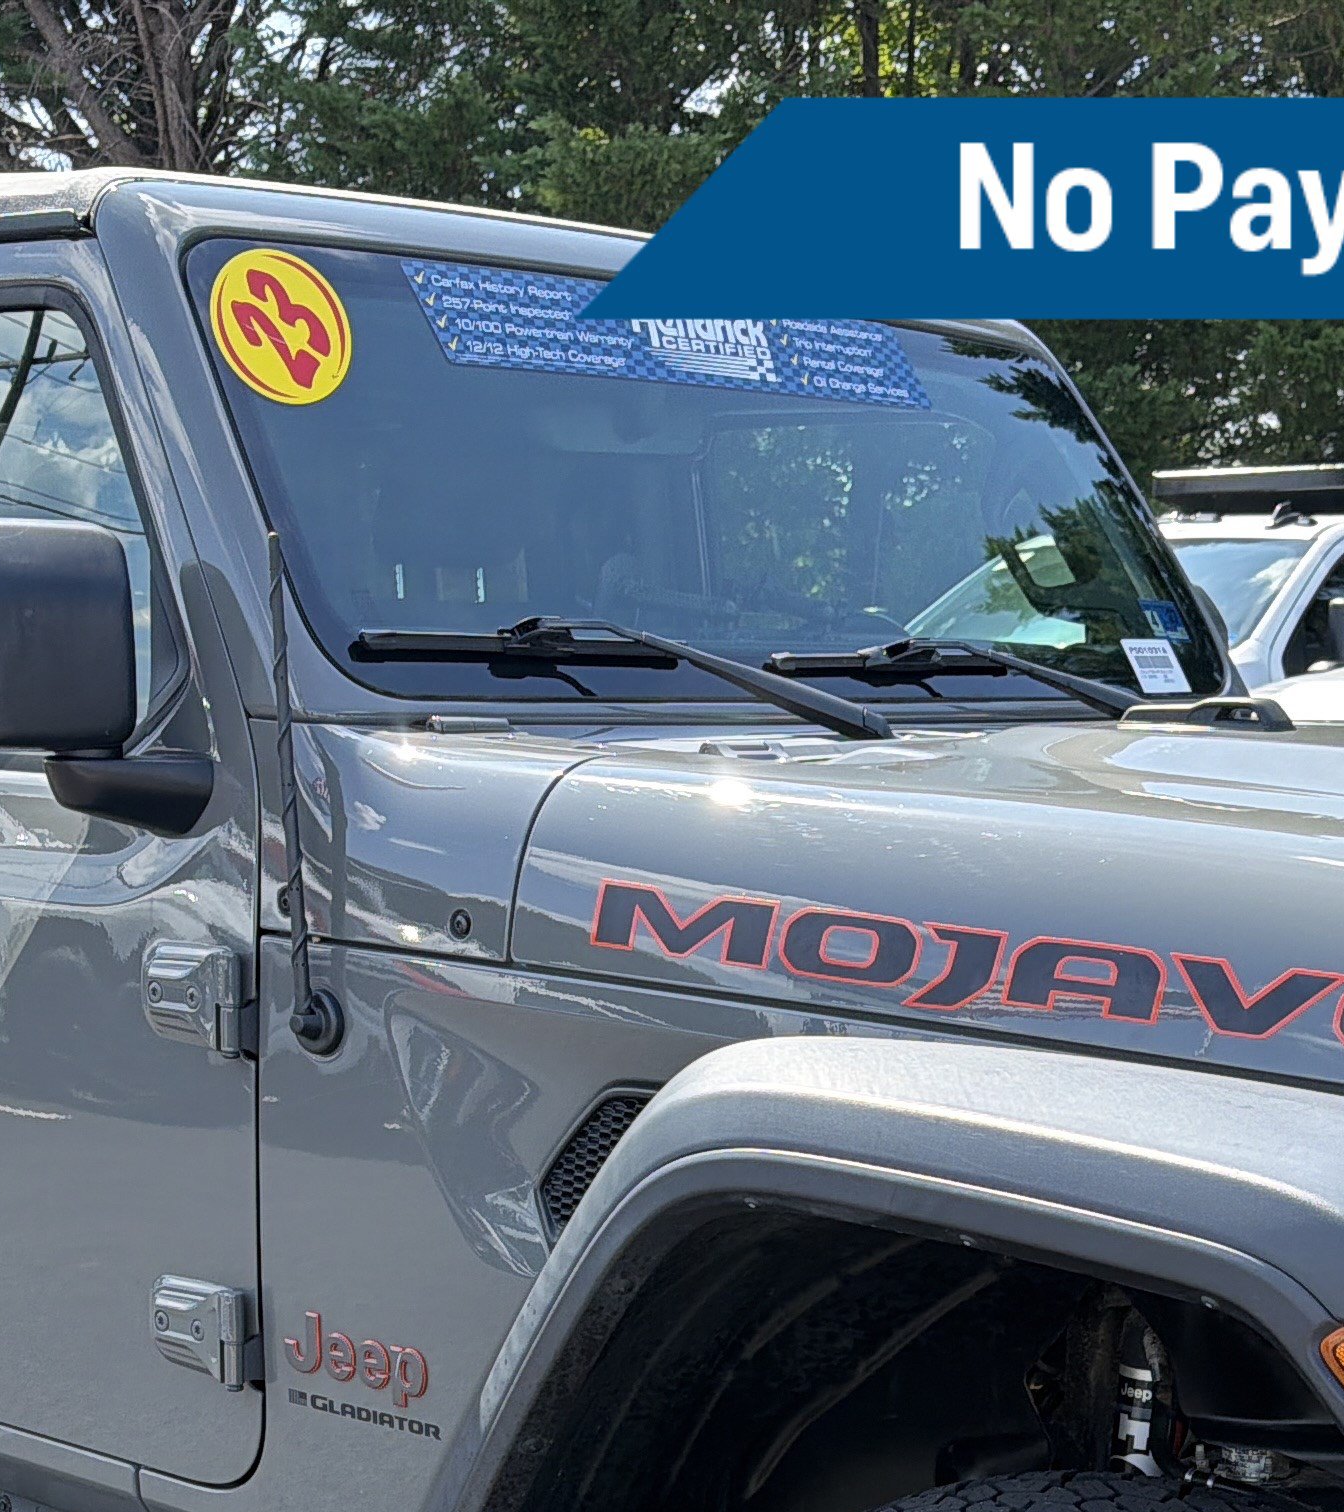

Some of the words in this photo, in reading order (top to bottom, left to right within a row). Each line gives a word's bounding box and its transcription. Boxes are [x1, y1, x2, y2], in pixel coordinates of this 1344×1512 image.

[431, 274, 475, 291] Carfax
[479, 280, 524, 297] History
[528, 285, 573, 301] Report
[231, 268, 331, 389] 23
[454, 318, 502, 334] 10/100
[505, 322, 574, 342] Powertrain
[577, 330, 635, 350] Warranty
[466, 340, 503, 355] 12/12
[507, 344, 566, 361] High-Tech
[568, 350, 627, 368] Coverage
[662, 336, 772, 360] CERTIFIED
[837, 361, 884, 378] Coverage
[867, 383, 910, 399] Services
[284, 1311, 429, 1408] Jeep
[1121, 1382, 1153, 1403] Jeep
[310, 1395, 442, 1441] GLADIATOR
